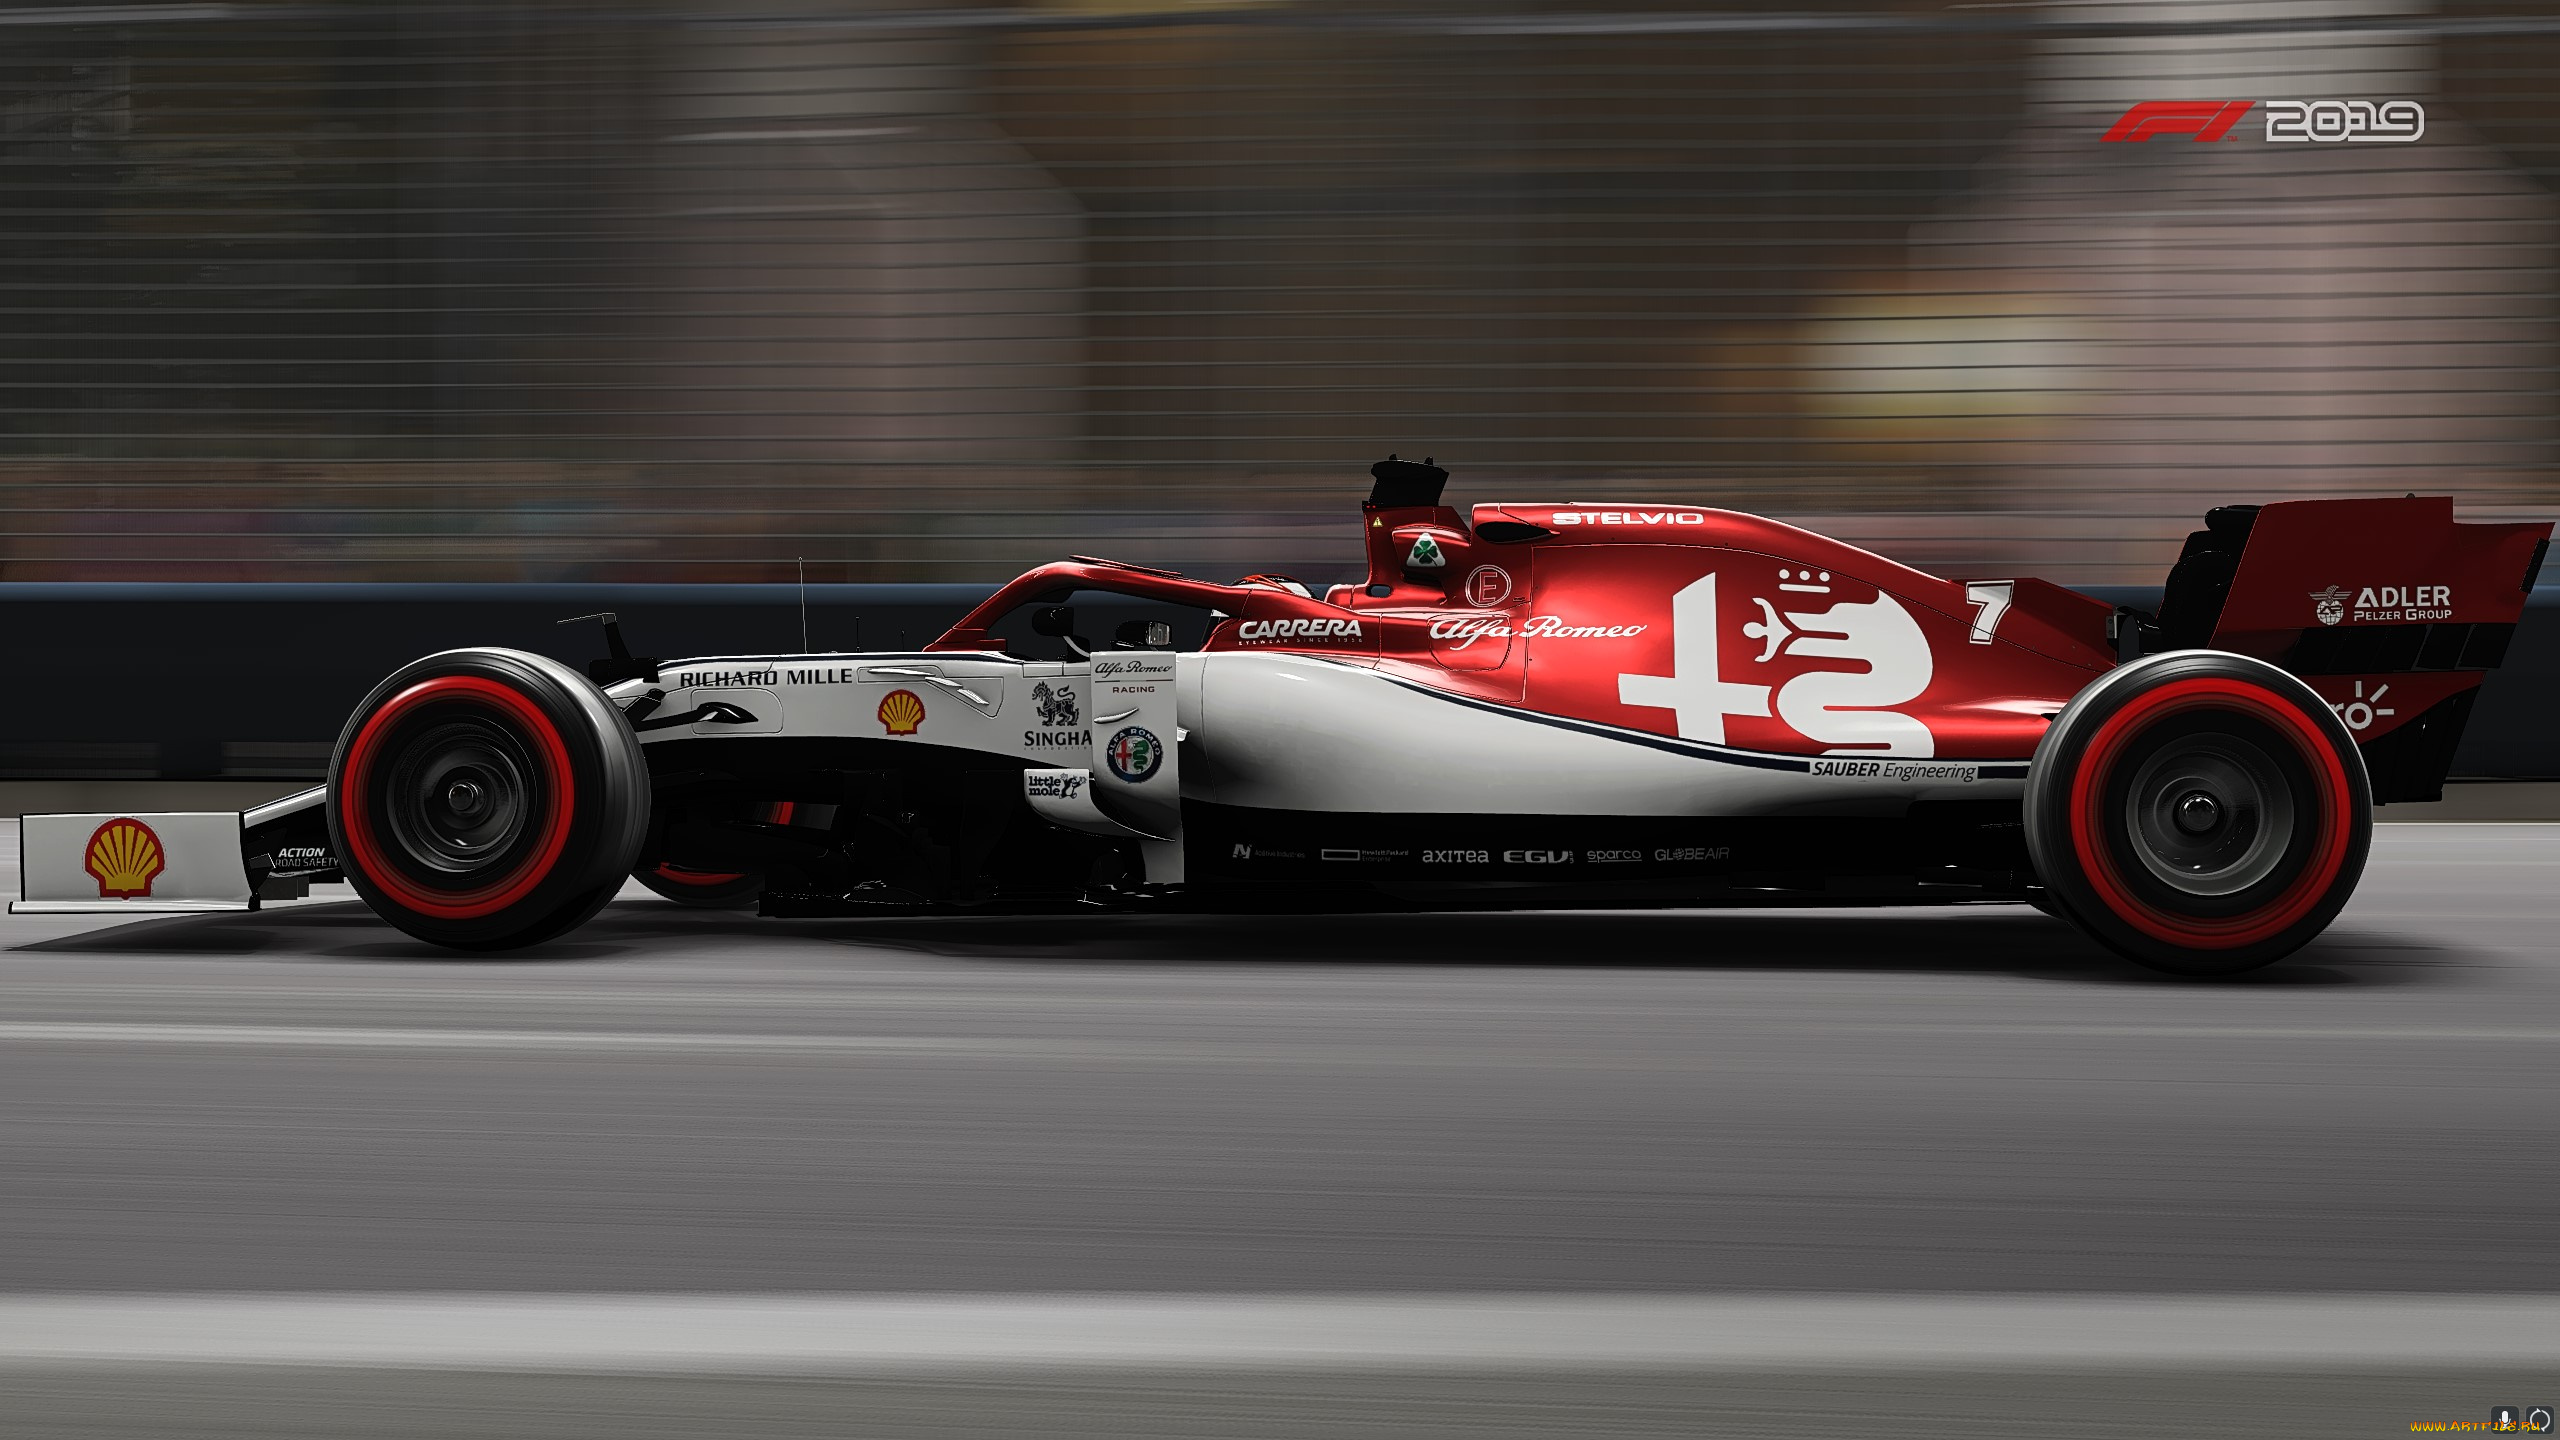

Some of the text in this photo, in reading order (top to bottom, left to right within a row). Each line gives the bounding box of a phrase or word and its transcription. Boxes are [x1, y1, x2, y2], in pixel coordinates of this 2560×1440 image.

[1552, 512, 1704, 525] STELVIO
[1478, 571, 1498, 603] E
[2353, 585, 2451, 608] ADLER
[1966, 580, 2014, 645] 7
[2353, 608, 2453, 622] PELZER GROUP
[1239, 619, 1362, 639] CARRERA
[1430, 616, 1647, 650] Alfa Romeo
[680, 668, 853, 688] RICHARD MILLE
[1095, 660, 1172, 678] Alfa Romeo
[1024, 730, 1092, 746] SINGHA
[1108, 728, 1161, 756] ALFA ROMEO
[1028, 775, 1061, 786] little
[1812, 761, 1976, 783] SAUBER Engineering
[1028, 784, 1061, 796] mole
[275, 857, 339, 867] ROAD SAFETY
[278, 848, 325, 858] ACTION
[1586, 850, 1642, 863] sparco
